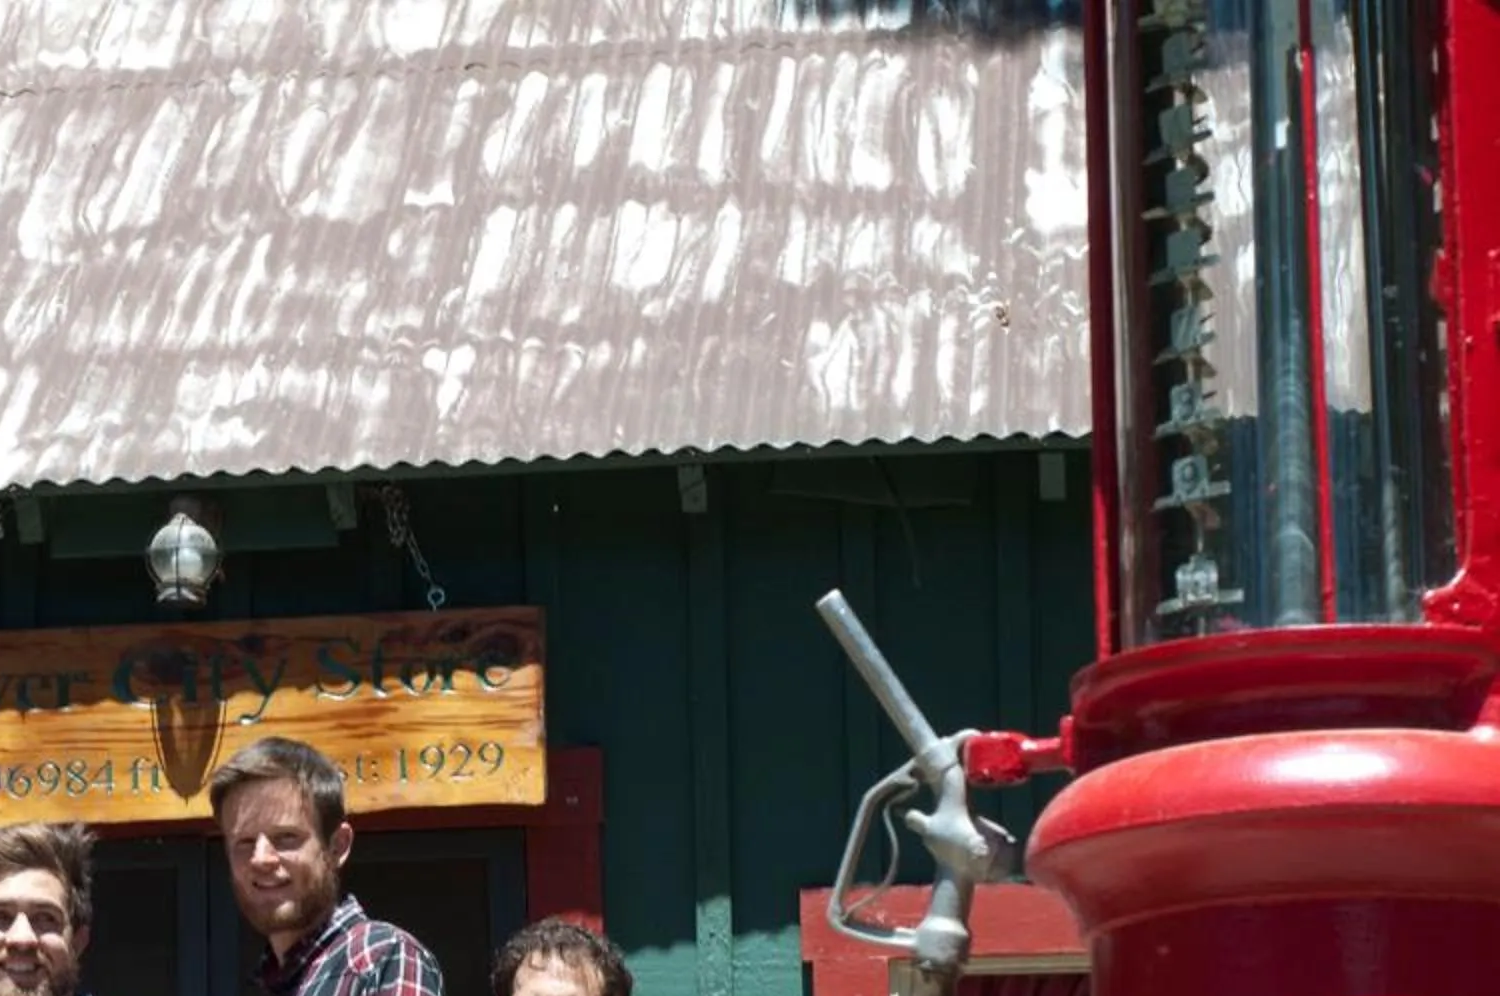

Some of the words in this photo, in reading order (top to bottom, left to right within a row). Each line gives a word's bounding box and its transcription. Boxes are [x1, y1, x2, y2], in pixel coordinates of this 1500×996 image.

[112, 643, 288, 726] City
[314, 639, 512, 700] Store
[5, 758, 115, 799] 6984
[398, 741, 505, 783] 1929
